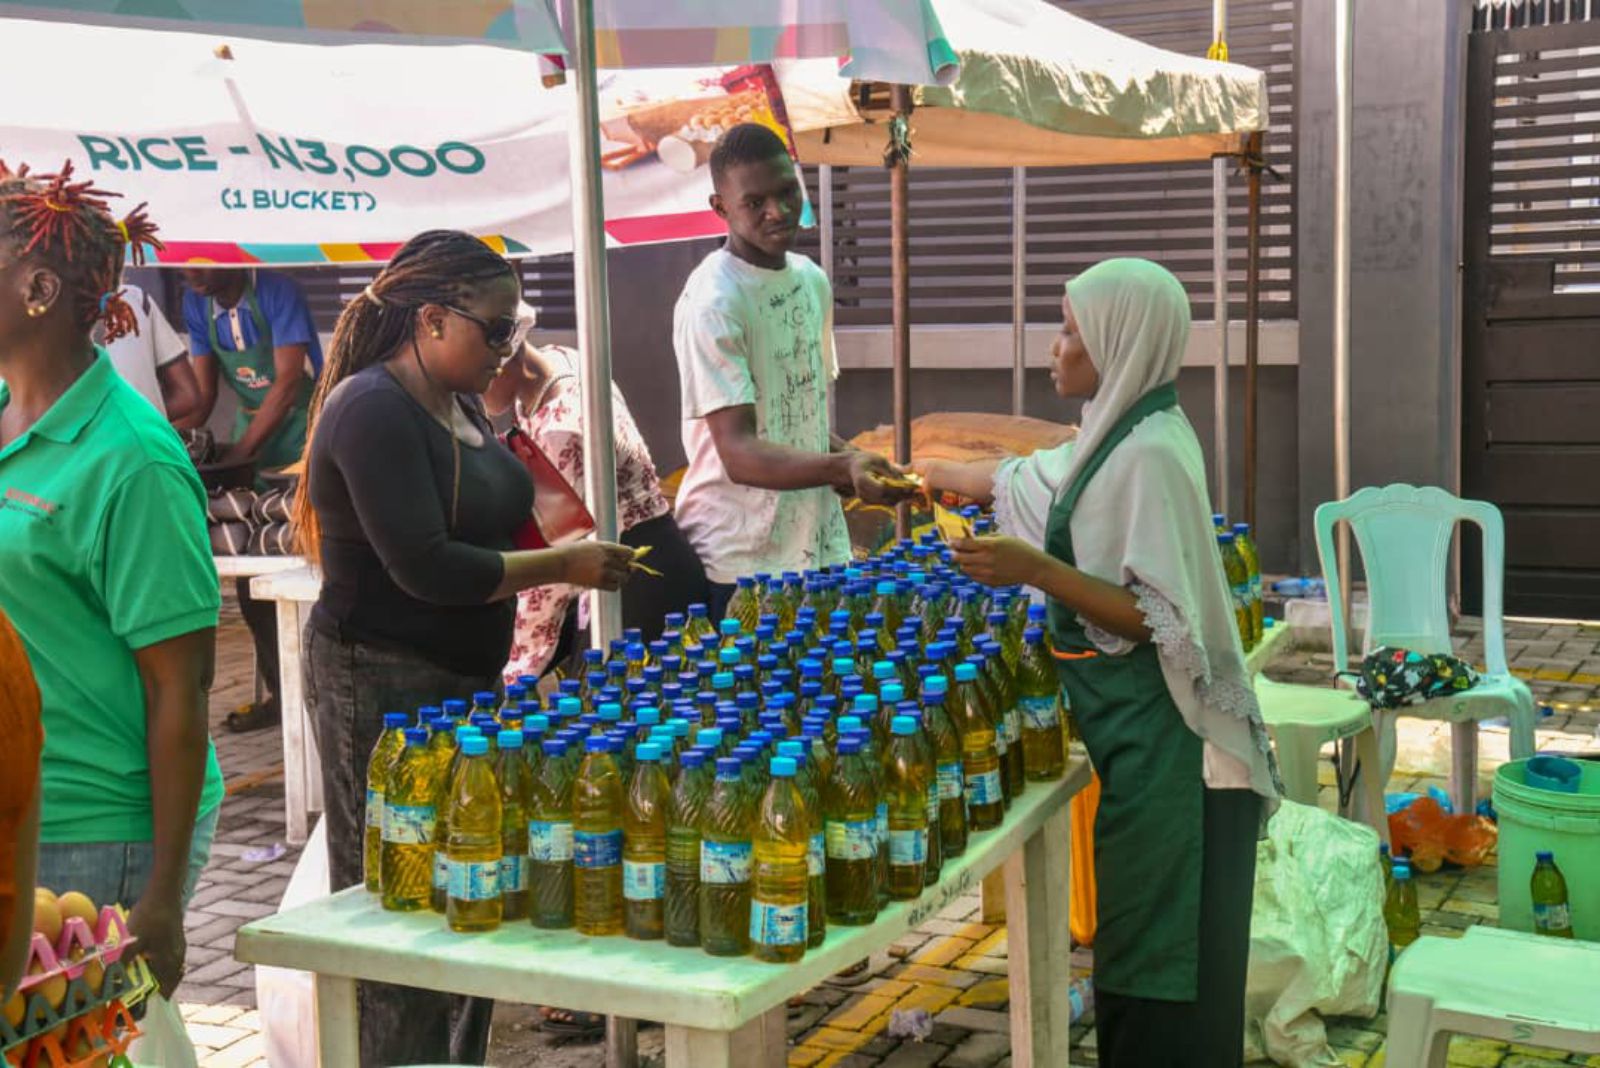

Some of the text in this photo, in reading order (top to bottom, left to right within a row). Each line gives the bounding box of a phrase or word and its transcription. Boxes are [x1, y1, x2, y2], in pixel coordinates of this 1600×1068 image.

[77, 132, 486, 183] RICE - N3,000
[220, 187, 377, 212] (1 BUCKET)
